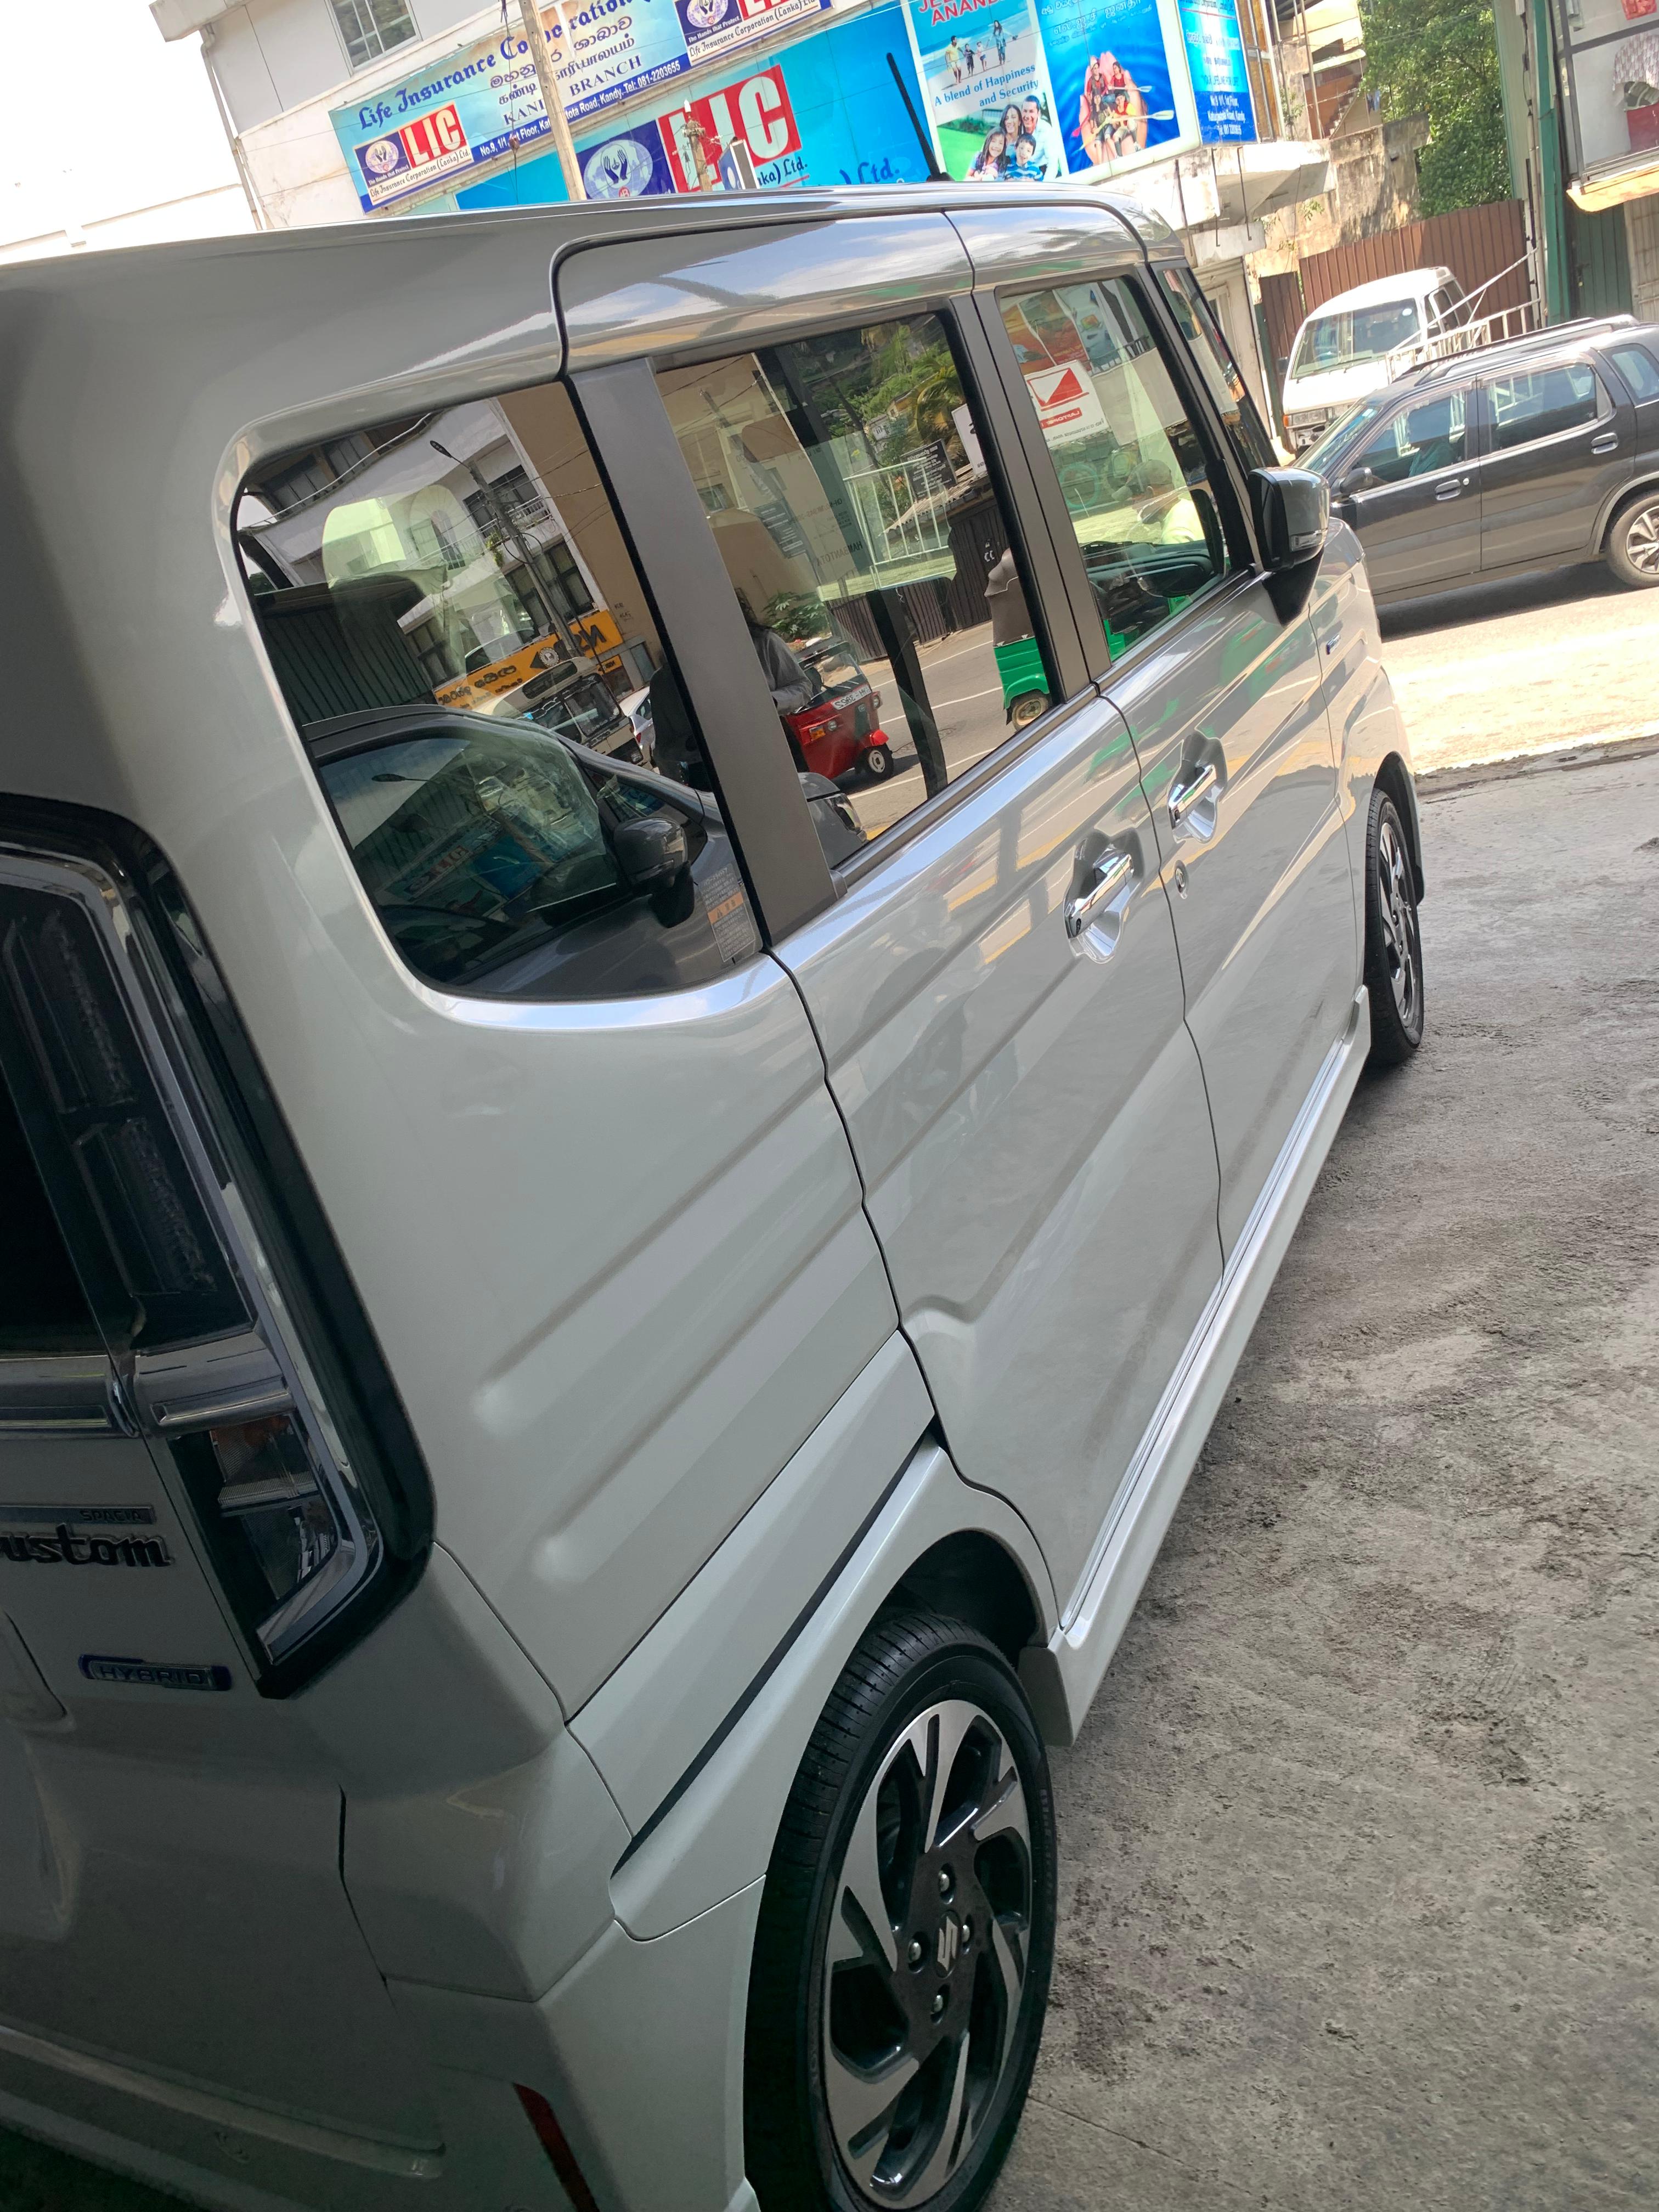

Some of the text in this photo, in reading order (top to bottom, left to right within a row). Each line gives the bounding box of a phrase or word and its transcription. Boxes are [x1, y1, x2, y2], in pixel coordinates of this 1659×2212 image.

[689, 0, 802, 57] Life Insurance Corporation (Lanka)
[698, 29, 712, 40] Hands
[932, 0, 998, 26] ANAN
[490, 48, 562, 89] මහනුර
[503, 55, 642, 126] KAN BRANCH
[935, 64, 1036, 106] A blend of Happiness
[359, 102, 393, 130] Life
[395, 54, 496, 112] Insurance
[520, 126, 540, 139] Floor,
[539, 106, 579, 131] Kattota
[579, 98, 600, 114] Road,
[623, 82, 636, 94] Tel:
[637, 60, 681, 88] 081-2203655
[979, 80, 1039, 107] and Security
[404, 109, 461, 166] LIC
[668, 76, 789, 191] LIC
[370, 149, 471, 198] Life Insurance Corporation (Lanka) Ltd.
[783, 156, 808, 177] Ltd.
[0, 1522, 174, 1567] ustom
[99, 1666, 205, 1685] HYBRID
